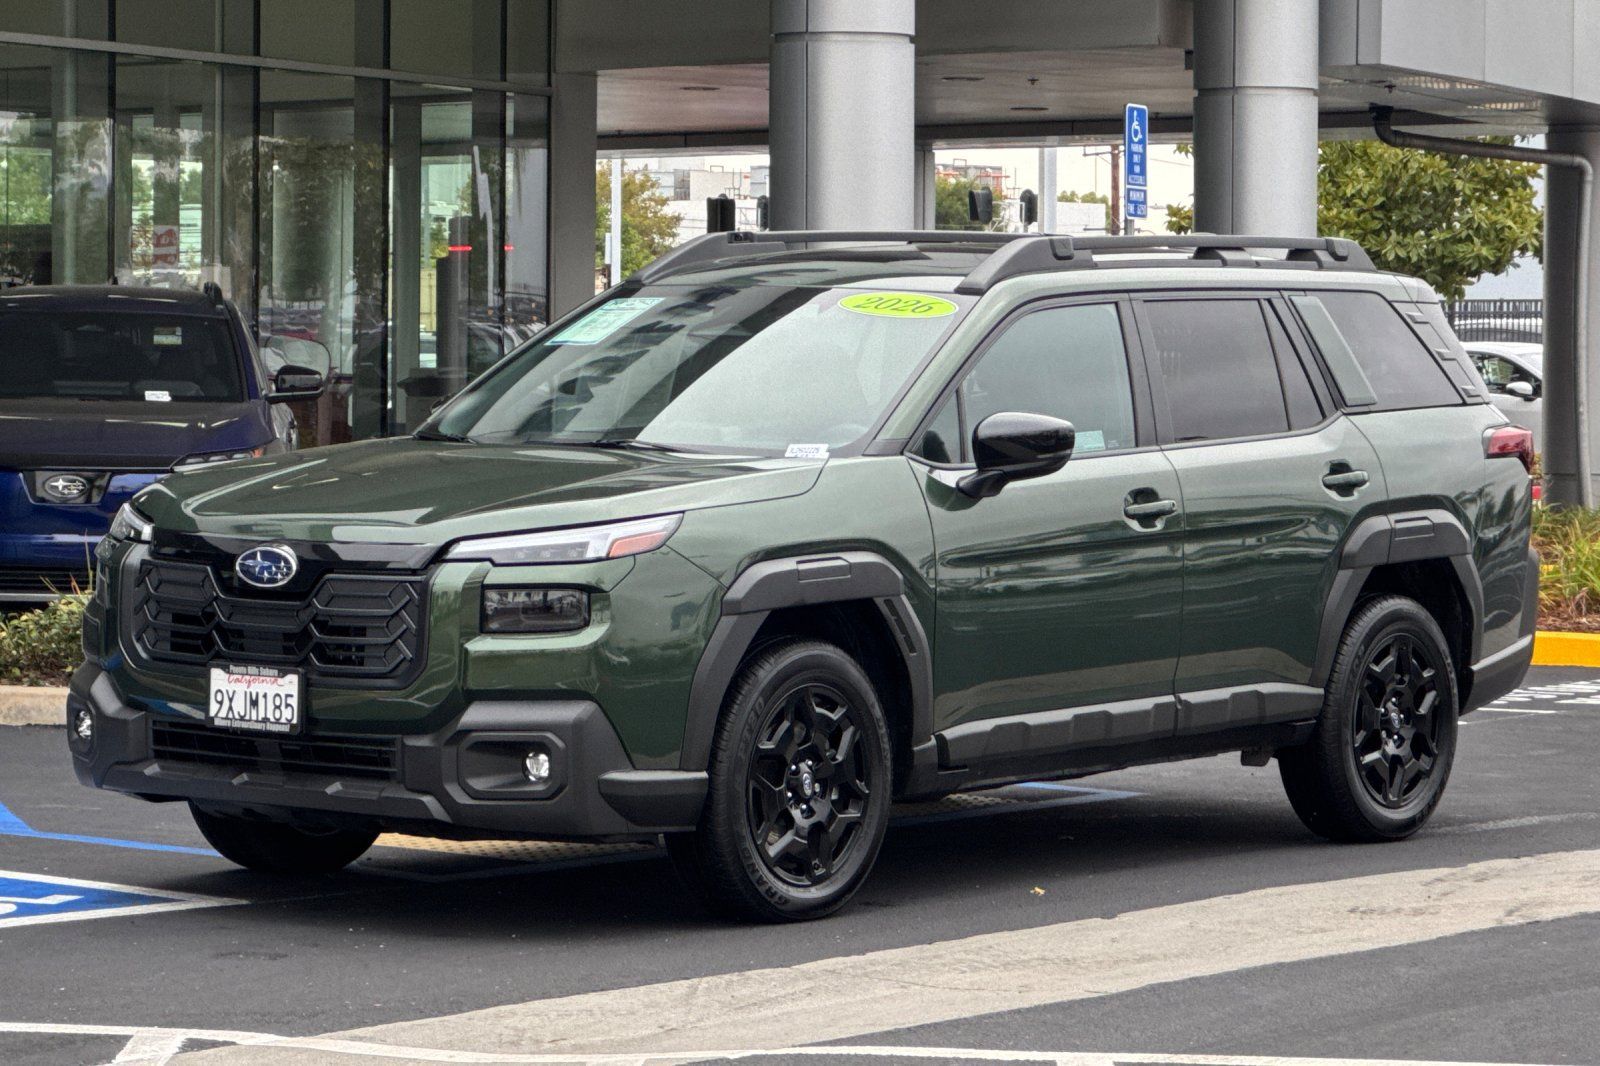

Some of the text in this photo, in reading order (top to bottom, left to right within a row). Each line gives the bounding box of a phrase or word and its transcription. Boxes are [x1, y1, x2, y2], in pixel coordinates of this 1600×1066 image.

[1130, 143, 1144, 153] PARKING
[1129, 190, 1145, 202] MINIMUM
[853, 296, 943, 314] 2026
[260, 667, 278, 677] Subaru
[227, 673, 284, 689] California
[214, 689, 295, 723] 9XJM185
[232, 719, 265, 731] Extraordinary
